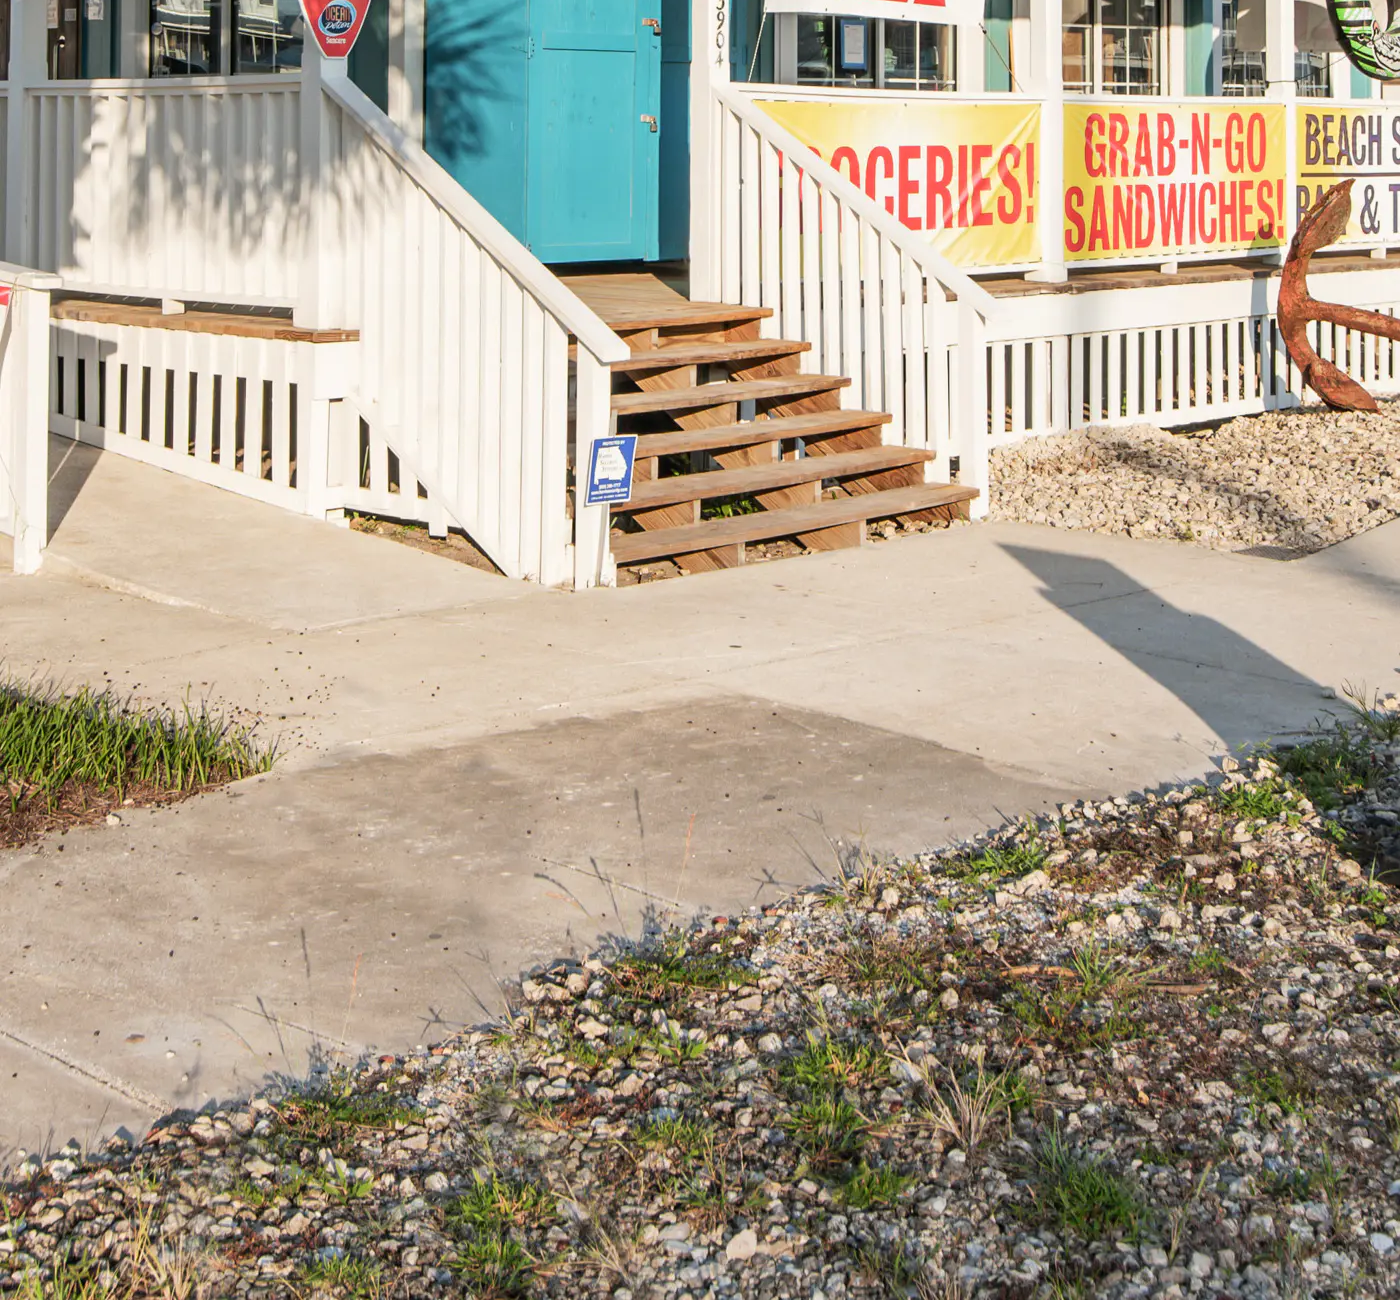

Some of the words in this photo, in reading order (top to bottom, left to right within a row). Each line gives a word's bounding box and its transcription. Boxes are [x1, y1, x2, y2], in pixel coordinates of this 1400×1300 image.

[325, 6, 351, 21] OCEAN
[1084, 112, 1267, 178] GRAB-N-GO
[1305, 113, 1382, 166] BEACH
[779, 142, 1035, 234] CERIES!
[1064, 178, 1284, 252] SANDWICHES!
[1360, 184, 1380, 235] &
